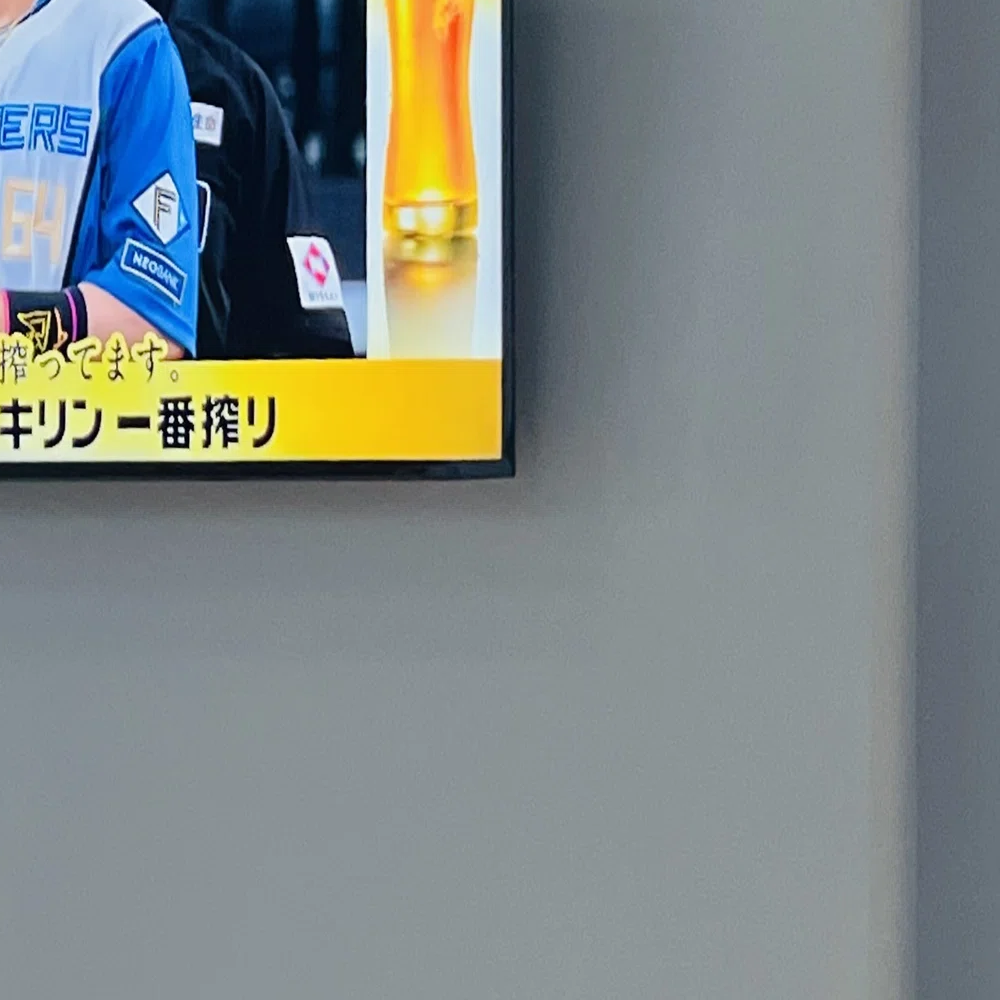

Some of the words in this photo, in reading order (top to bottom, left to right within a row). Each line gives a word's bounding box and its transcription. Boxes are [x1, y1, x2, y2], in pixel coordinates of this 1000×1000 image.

[2, 176, 66, 265] 64
[153, 185, 177, 233] F
[132, 250, 181, 293] NEOBANK
